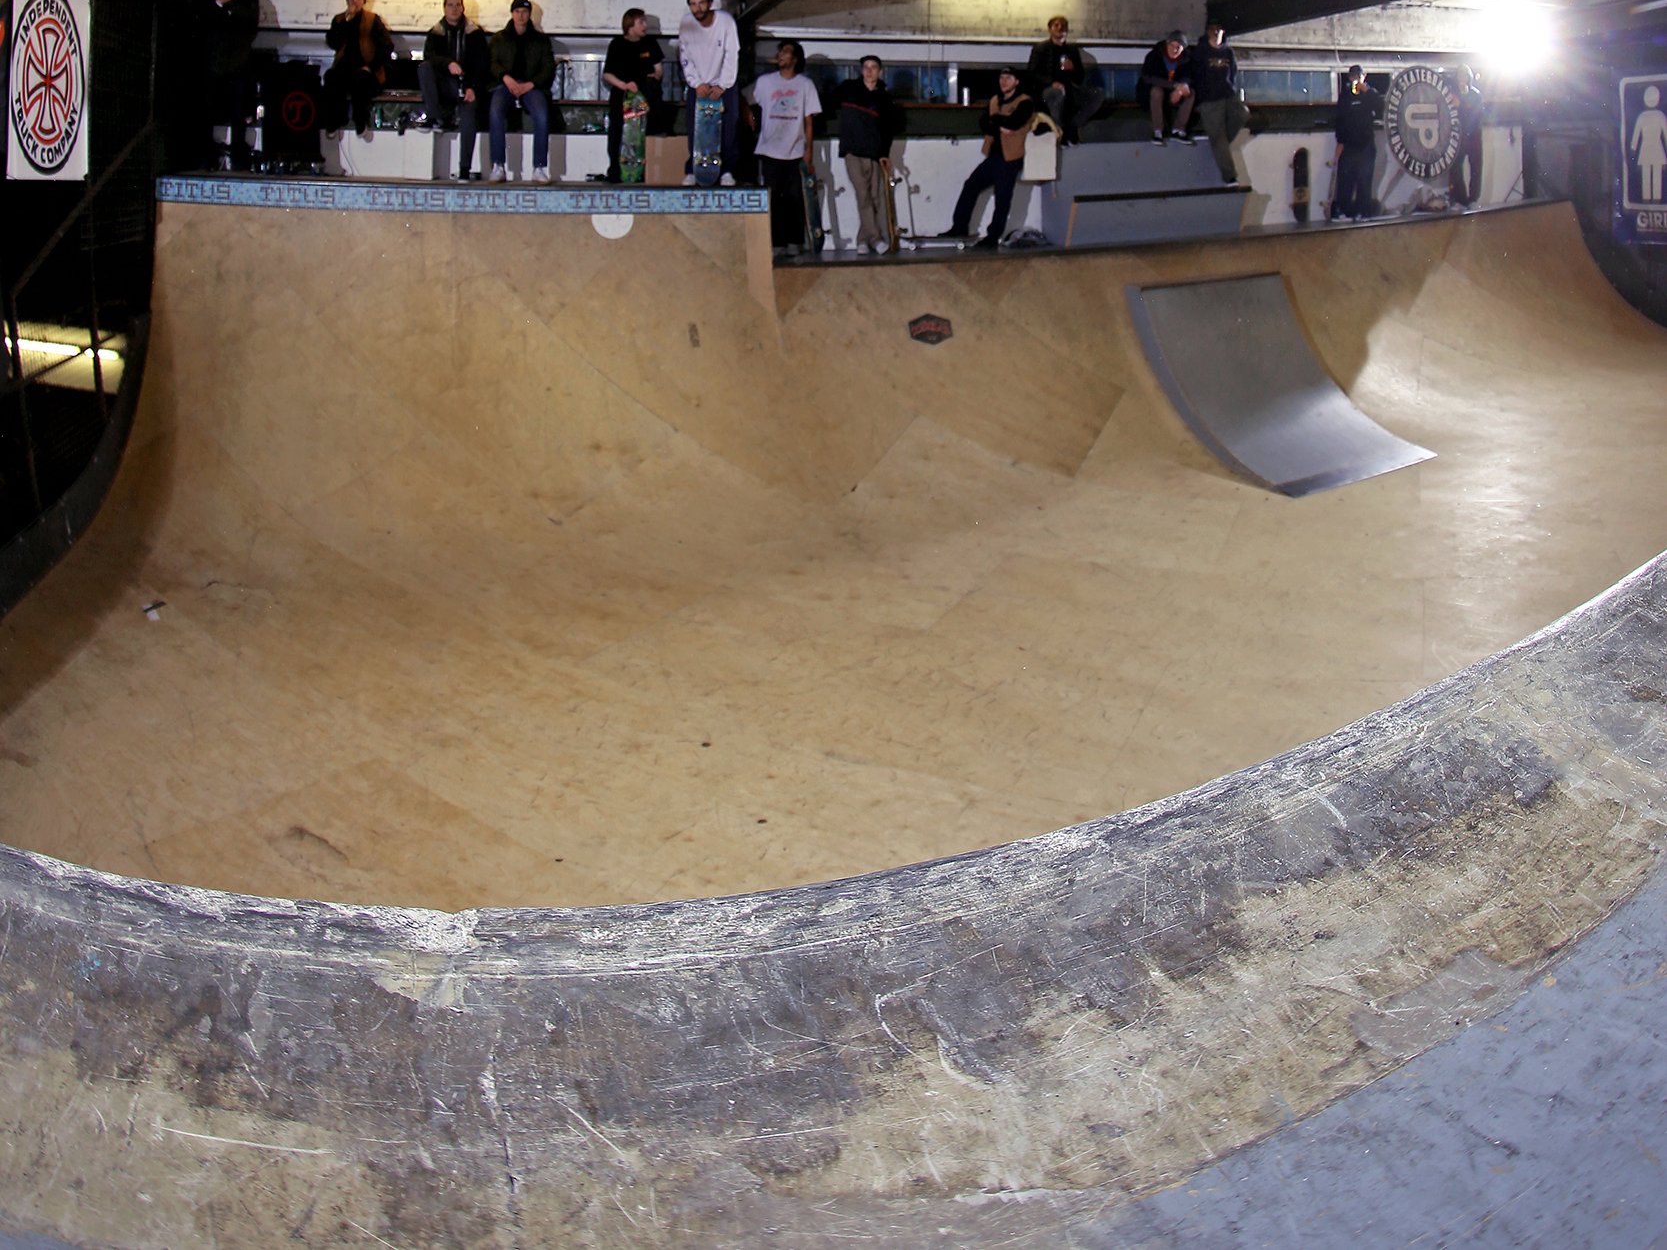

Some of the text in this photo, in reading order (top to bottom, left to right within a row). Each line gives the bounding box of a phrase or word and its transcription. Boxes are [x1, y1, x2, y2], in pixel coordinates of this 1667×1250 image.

[19, 0, 78, 57] INDEPENDENT
[14, 92, 78, 164] TRUCK COMPANY
[1430, 131, 1460, 177] COMPANY
[160, 180, 231, 200] TITUS
[260, 185, 335, 204] TITUS
[366, 189, 445, 208] TITUS
[456, 191, 538, 209] TITUS
[569, 193, 650, 209] TITUS
[682, 192, 762, 209] TITUS
